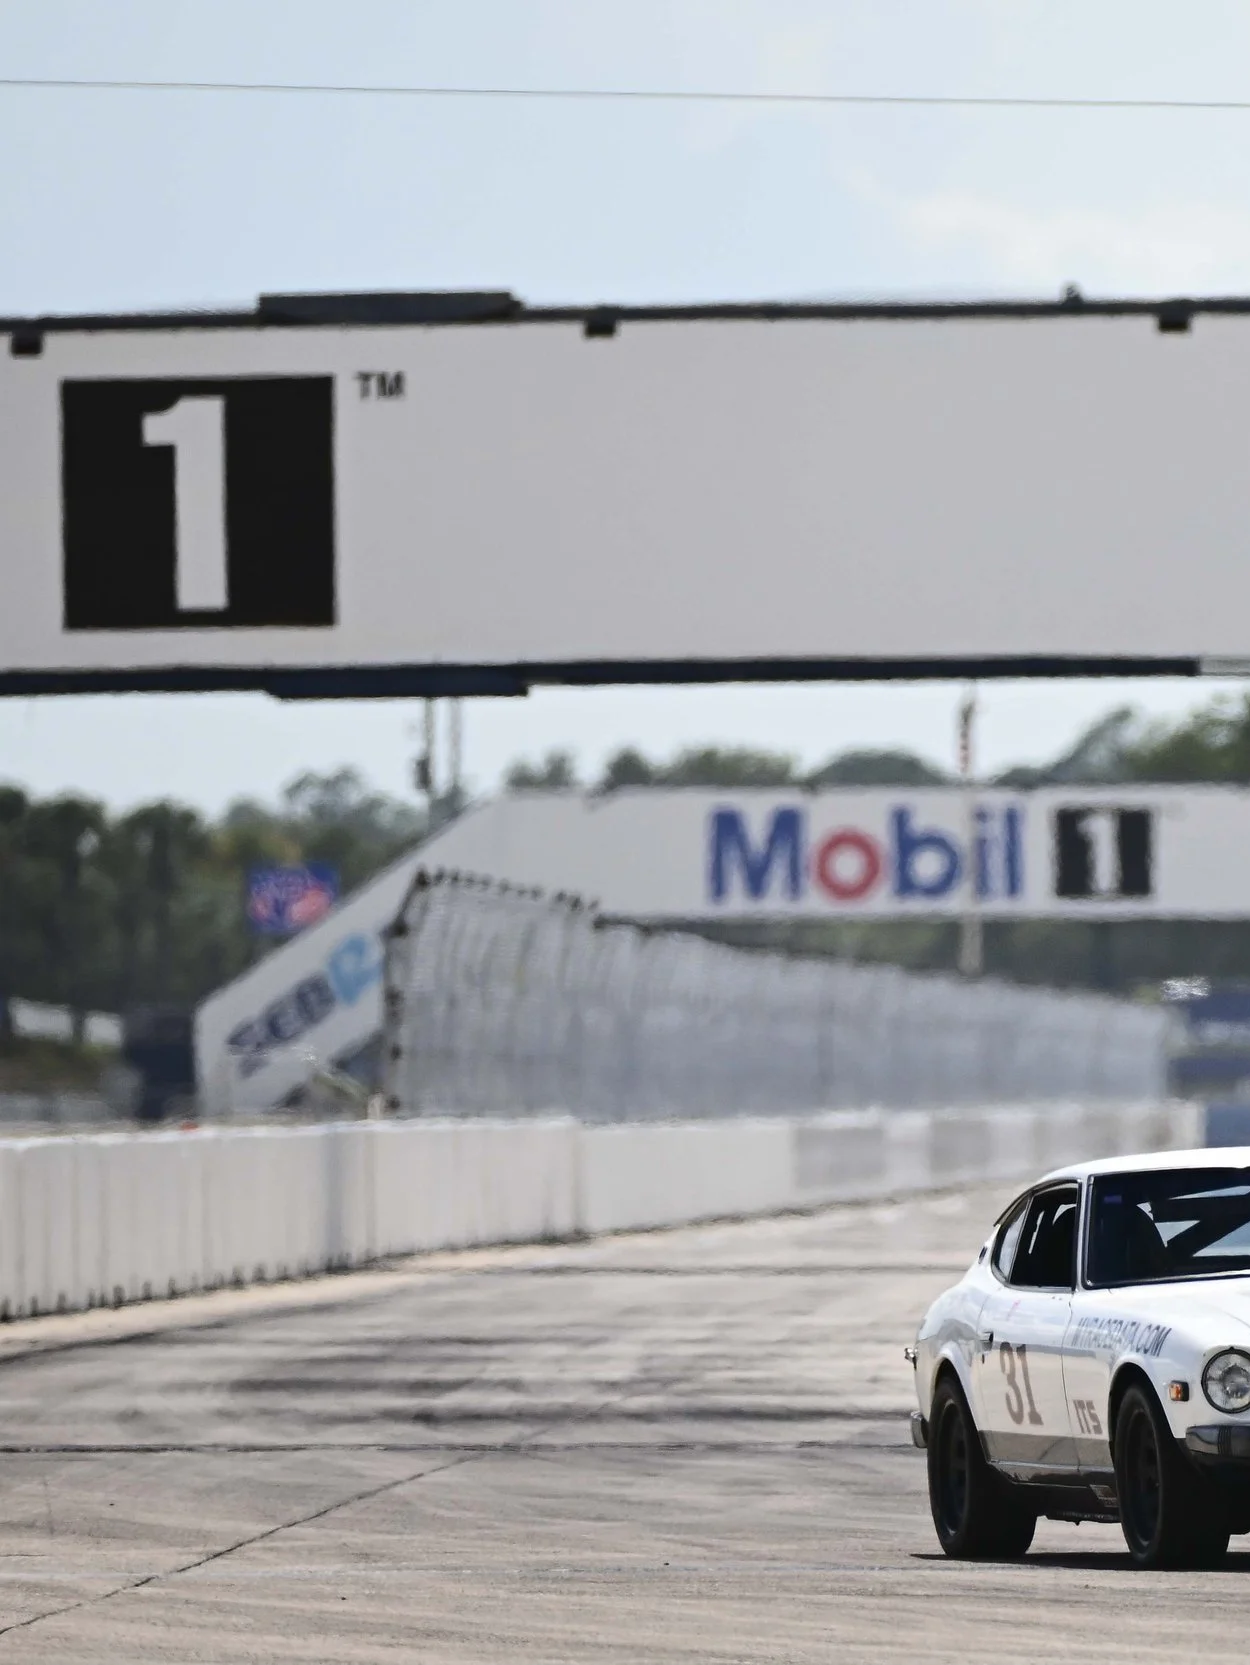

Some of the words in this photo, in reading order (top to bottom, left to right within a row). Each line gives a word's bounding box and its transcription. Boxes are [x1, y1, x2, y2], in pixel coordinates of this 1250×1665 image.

[357, 371, 406, 399] TM
[708, 804, 1022, 902] Mobil
[1000, 1341, 1044, 1426] 31
[1073, 1400, 1103, 1435] ITS
